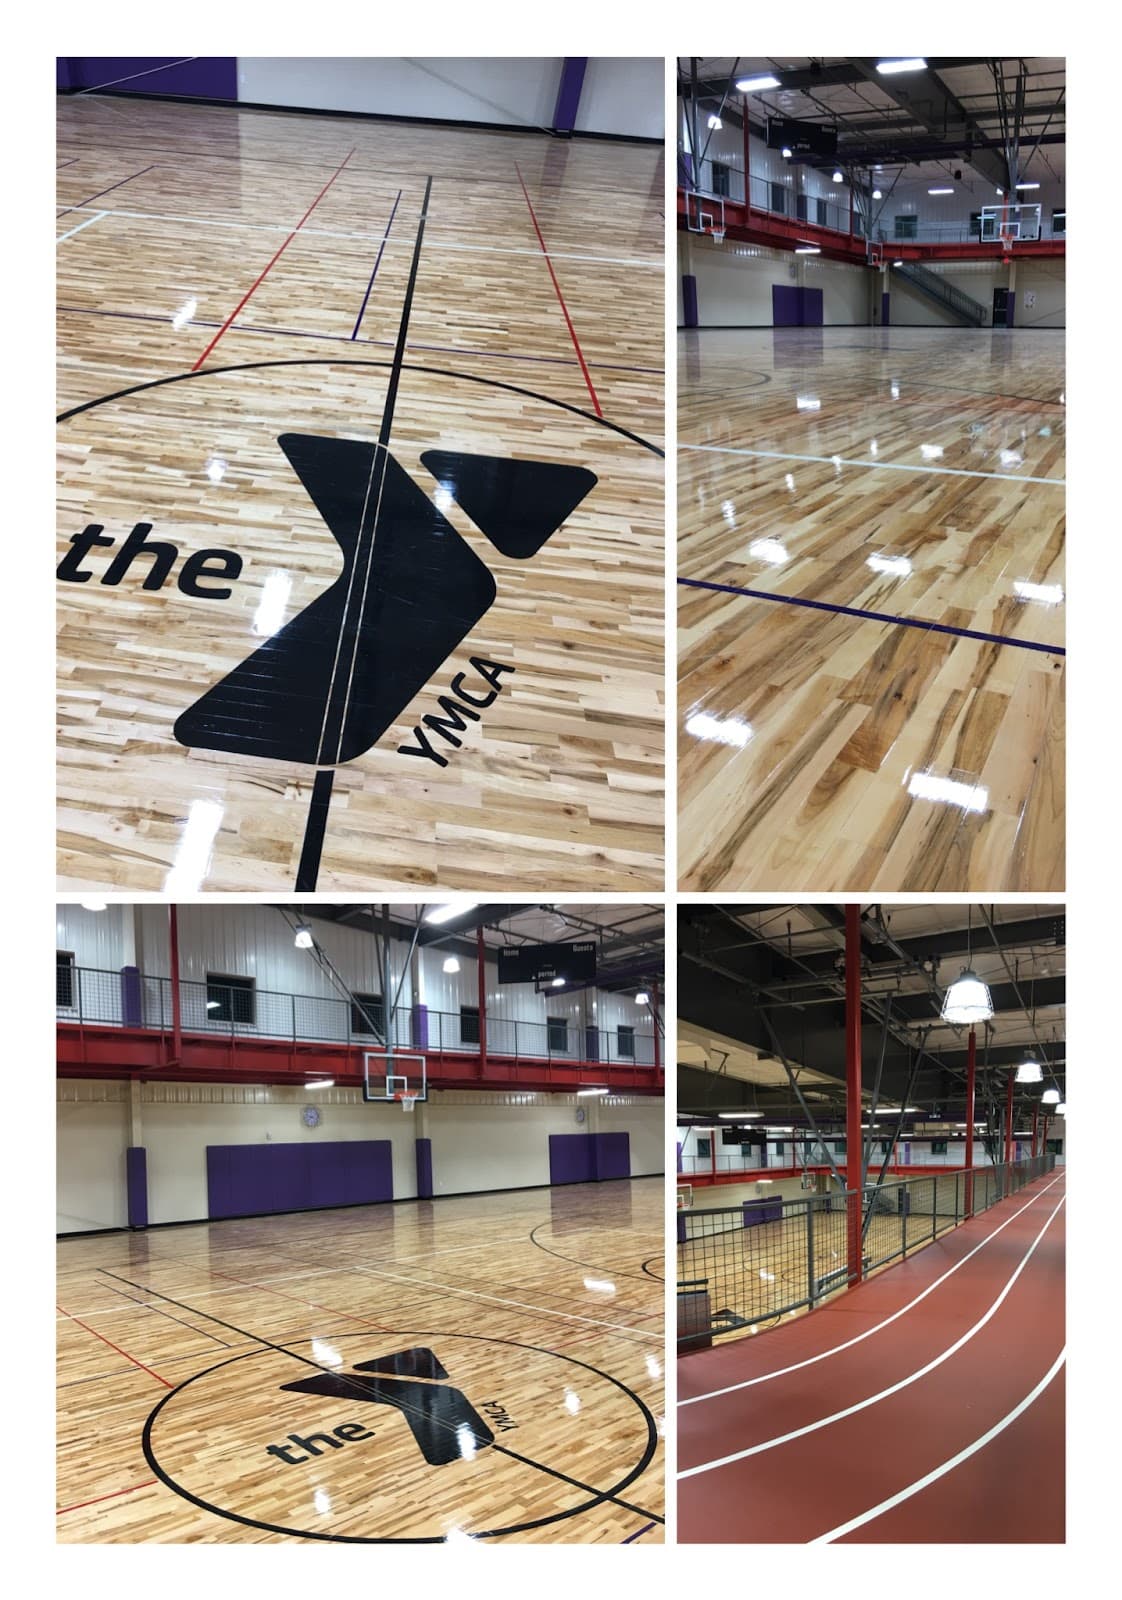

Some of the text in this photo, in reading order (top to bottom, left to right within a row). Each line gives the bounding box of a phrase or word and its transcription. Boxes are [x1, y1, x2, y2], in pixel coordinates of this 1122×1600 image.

[56, 522, 243, 600] the
[397, 656, 515, 768] YMCA
[265, 1423, 376, 1465] the
[481, 1400, 519, 1431] YMCA
